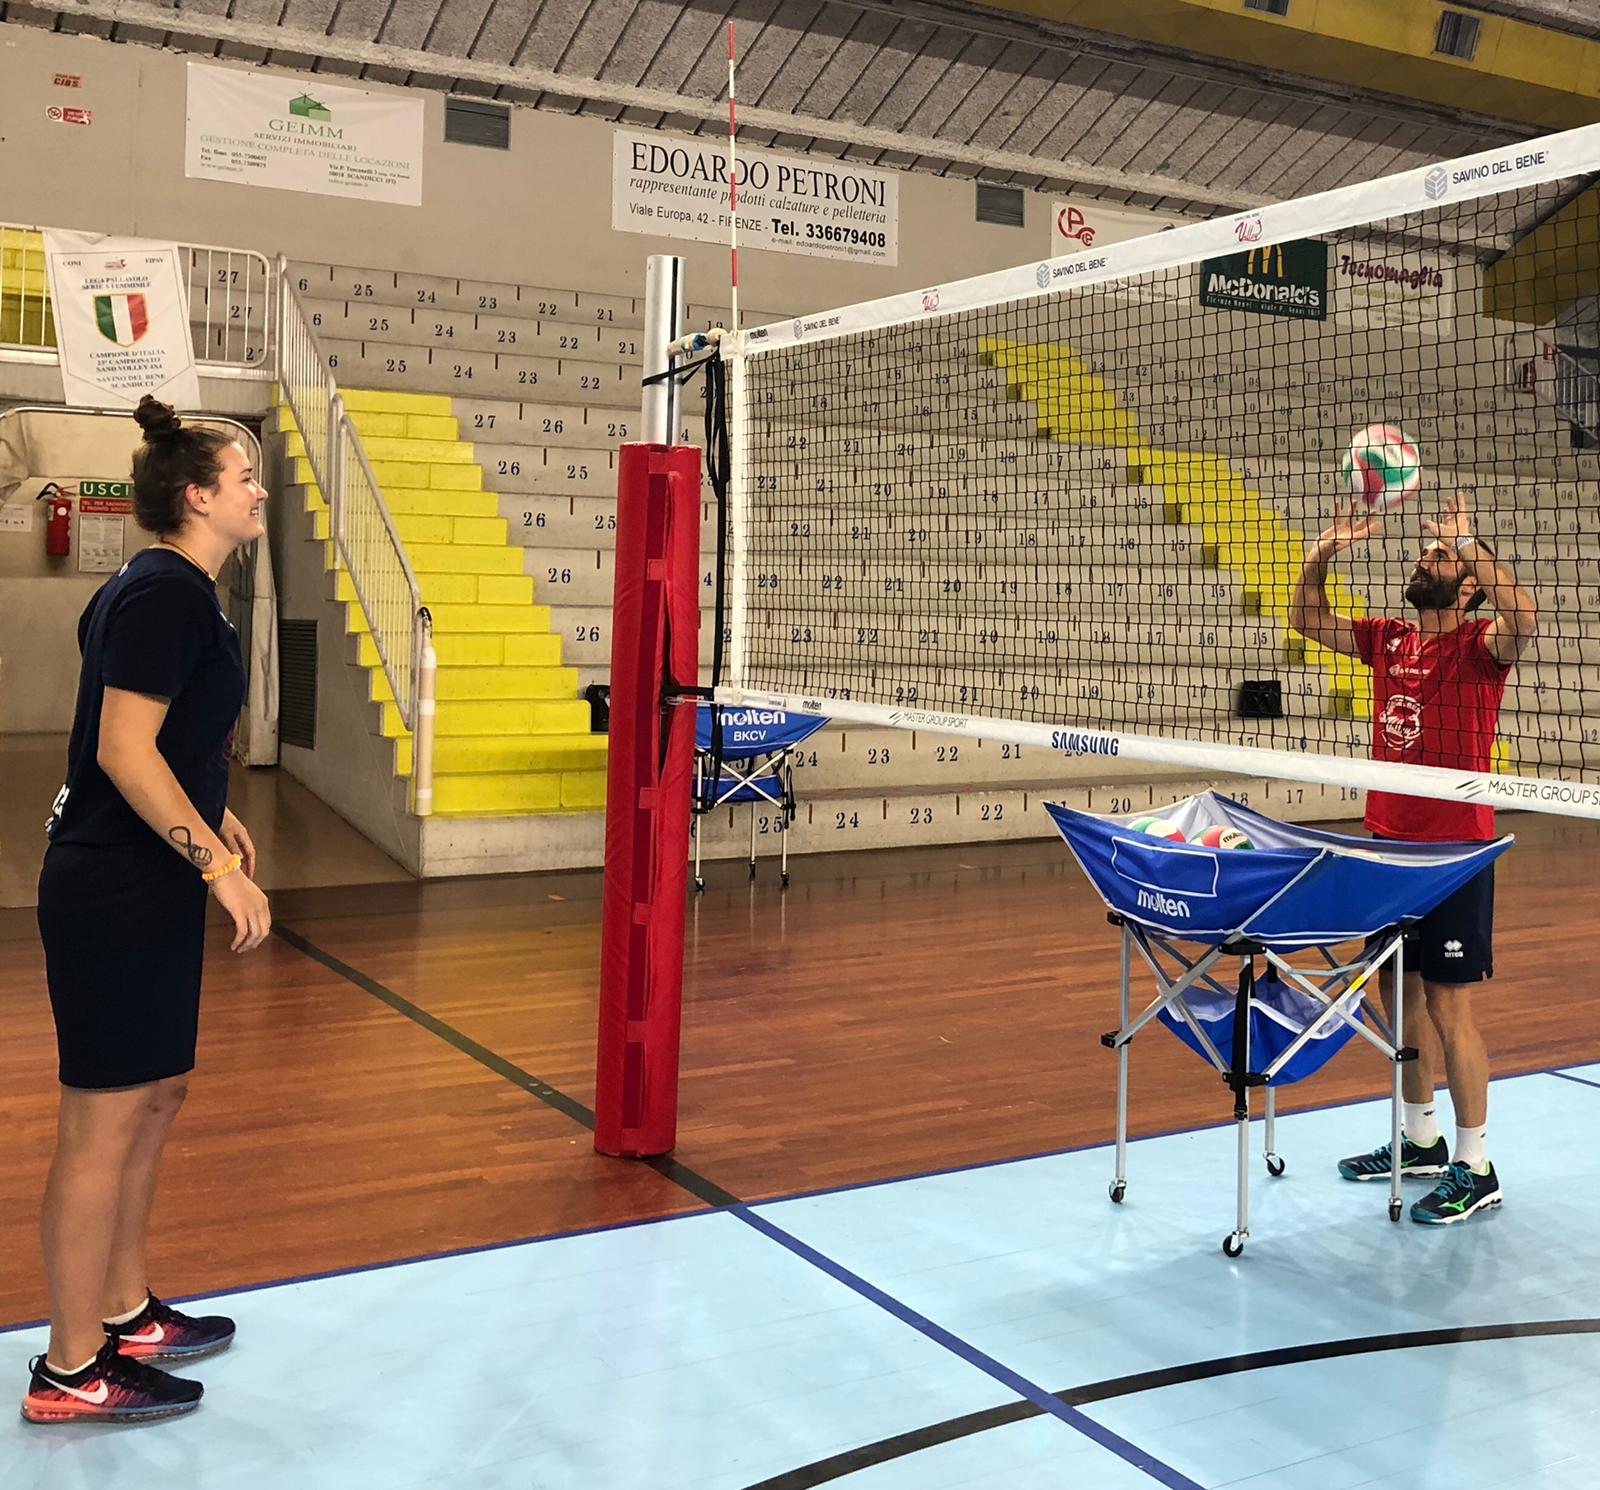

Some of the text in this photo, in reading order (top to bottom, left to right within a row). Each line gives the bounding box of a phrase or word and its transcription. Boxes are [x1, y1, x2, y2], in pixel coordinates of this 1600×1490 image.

[269, 119, 344, 140] GEIMM
[254, 132, 358, 153] SERVIZI IMMOBILIARI
[200, 135, 410, 171] GESTIONE COMPLETA DELLE LOCAZIONI
[631, 142, 886, 208] EDOARDO PETRONI
[1453, 152, 1545, 184] SAVINO DEL BENE
[629, 177, 717, 200] rappresentante
[769, 196, 820, 217] calzature
[823, 206, 829, 215] e
[831, 204, 886, 224] pelletteria
[629, 203, 654, 217] Viale
[656, 206, 694, 223] Europa,
[697, 213, 709, 225] 42
[772, 218, 799, 236] Tel.
[806, 223, 886, 248] 336679408
[1052, 258, 1106, 278] SAVINO DEL BENE
[354, 284, 373, 297] 25
[417, 290, 436, 303] 24
[1208, 273, 1320, 307] McDonald's
[479, 296, 497, 309] 23
[538, 303, 557, 316] 22
[597, 309, 613, 322] 21
[369, 319, 389, 332] 25
[435, 324, 454, 338] 24
[498, 330, 516, 344] 23
[560, 336, 578, 349] 22
[618, 342, 635, 355] 21
[118, 364, 147, 372] VOLLEY
[386, 359, 407, 373] 25
[453, 365, 473, 379] 24
[518, 371, 538, 385] 23
[580, 376, 600, 390] 22
[863, 401, 879, 413] 17
[474, 414, 496, 429] 27
[542, 419, 563, 434] 26
[608, 423, 627, 438] 25
[788, 436, 807, 449] 22
[843, 441, 861, 454] 21
[949, 448, 966, 460] 19
[498, 461, 520, 476] 26
[567, 465, 588, 480] 25
[817, 479, 834, 493] 21
[874, 483, 891, 496] 20
[523, 512, 546, 528] 26
[594, 515, 616, 530] 25
[791, 523, 811, 537] 22
[852, 526, 871, 540] 21
[908, 528, 926, 542] 20
[1019, 532, 1036, 545] 18
[1396, 549, 1409, 561] 12
[548, 568, 571, 584] 26
[885, 577, 903, 592] 21
[1108, 583, 1124, 596] 17
[1211, 585, 1226, 598] 15
[576, 626, 600, 642] 26
[792, 628, 812, 643] 23
[858, 629, 878, 643] 22
[919, 629, 938, 643] 21
[980, 630, 998, 643] 20
[1038, 630, 1056, 644] 19
[1094, 631, 1111, 644] 18
[1147, 632, 1162, 645] 17
[1253, 632, 1267, 645] 15
[896, 687, 918, 702] 22
[960, 687, 978, 702] 21
[1020, 686, 1039, 700] 20
[1080, 685, 1099, 699] 19
[1192, 685, 1208, 698] 17
[1298, 683, 1312, 695] 15
[903, 711, 926, 724] MASTER
[733, 730, 767, 742] BKCV
[1346, 735, 1360, 748] 15
[1543, 731, 1556, 743] 13
[1584, 729, 1598, 741] 12
[1052, 730, 1120, 756] SAMSUNG
[867, 748, 890, 764] 23
[936, 746, 959, 761] 22
[1002, 744, 1021, 759] 21
[795, 751, 818, 767] 24
[1286, 789, 1304, 804] 17
[1340, 786, 1357, 802] 16
[1488, 780, 1538, 798] MASTER
[1541, 785, 1591, 804] GROUP
[981, 804, 1003, 821] 22
[1111, 797, 1132, 814] 20
[836, 812, 859, 829] 24
[910, 808, 933, 824] 23
[1137, 888, 1190, 918] molten
